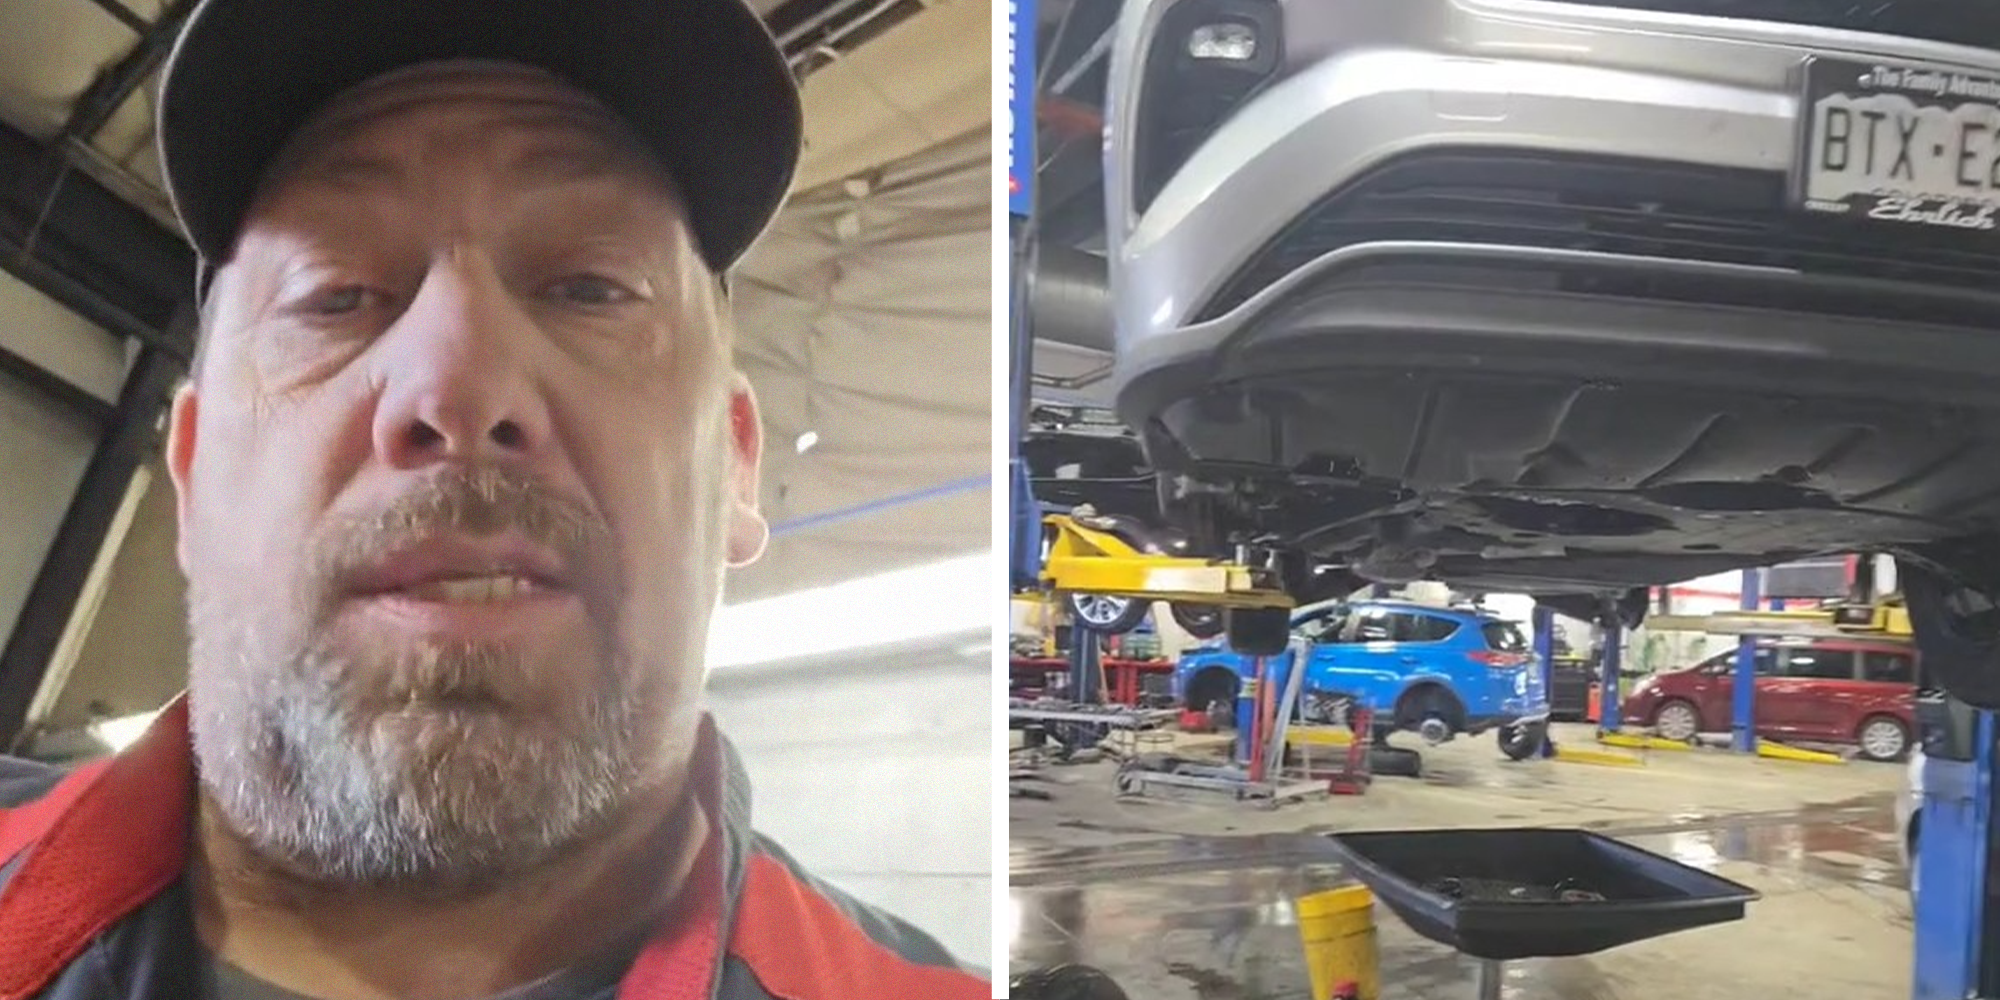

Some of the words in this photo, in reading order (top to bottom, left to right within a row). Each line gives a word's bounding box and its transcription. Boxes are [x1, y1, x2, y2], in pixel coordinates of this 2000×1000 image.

[1872, 66, 1900, 88] The
[1903, 69, 1949, 97] Family
[1868, 198, 1996, 229] Ehrlich
